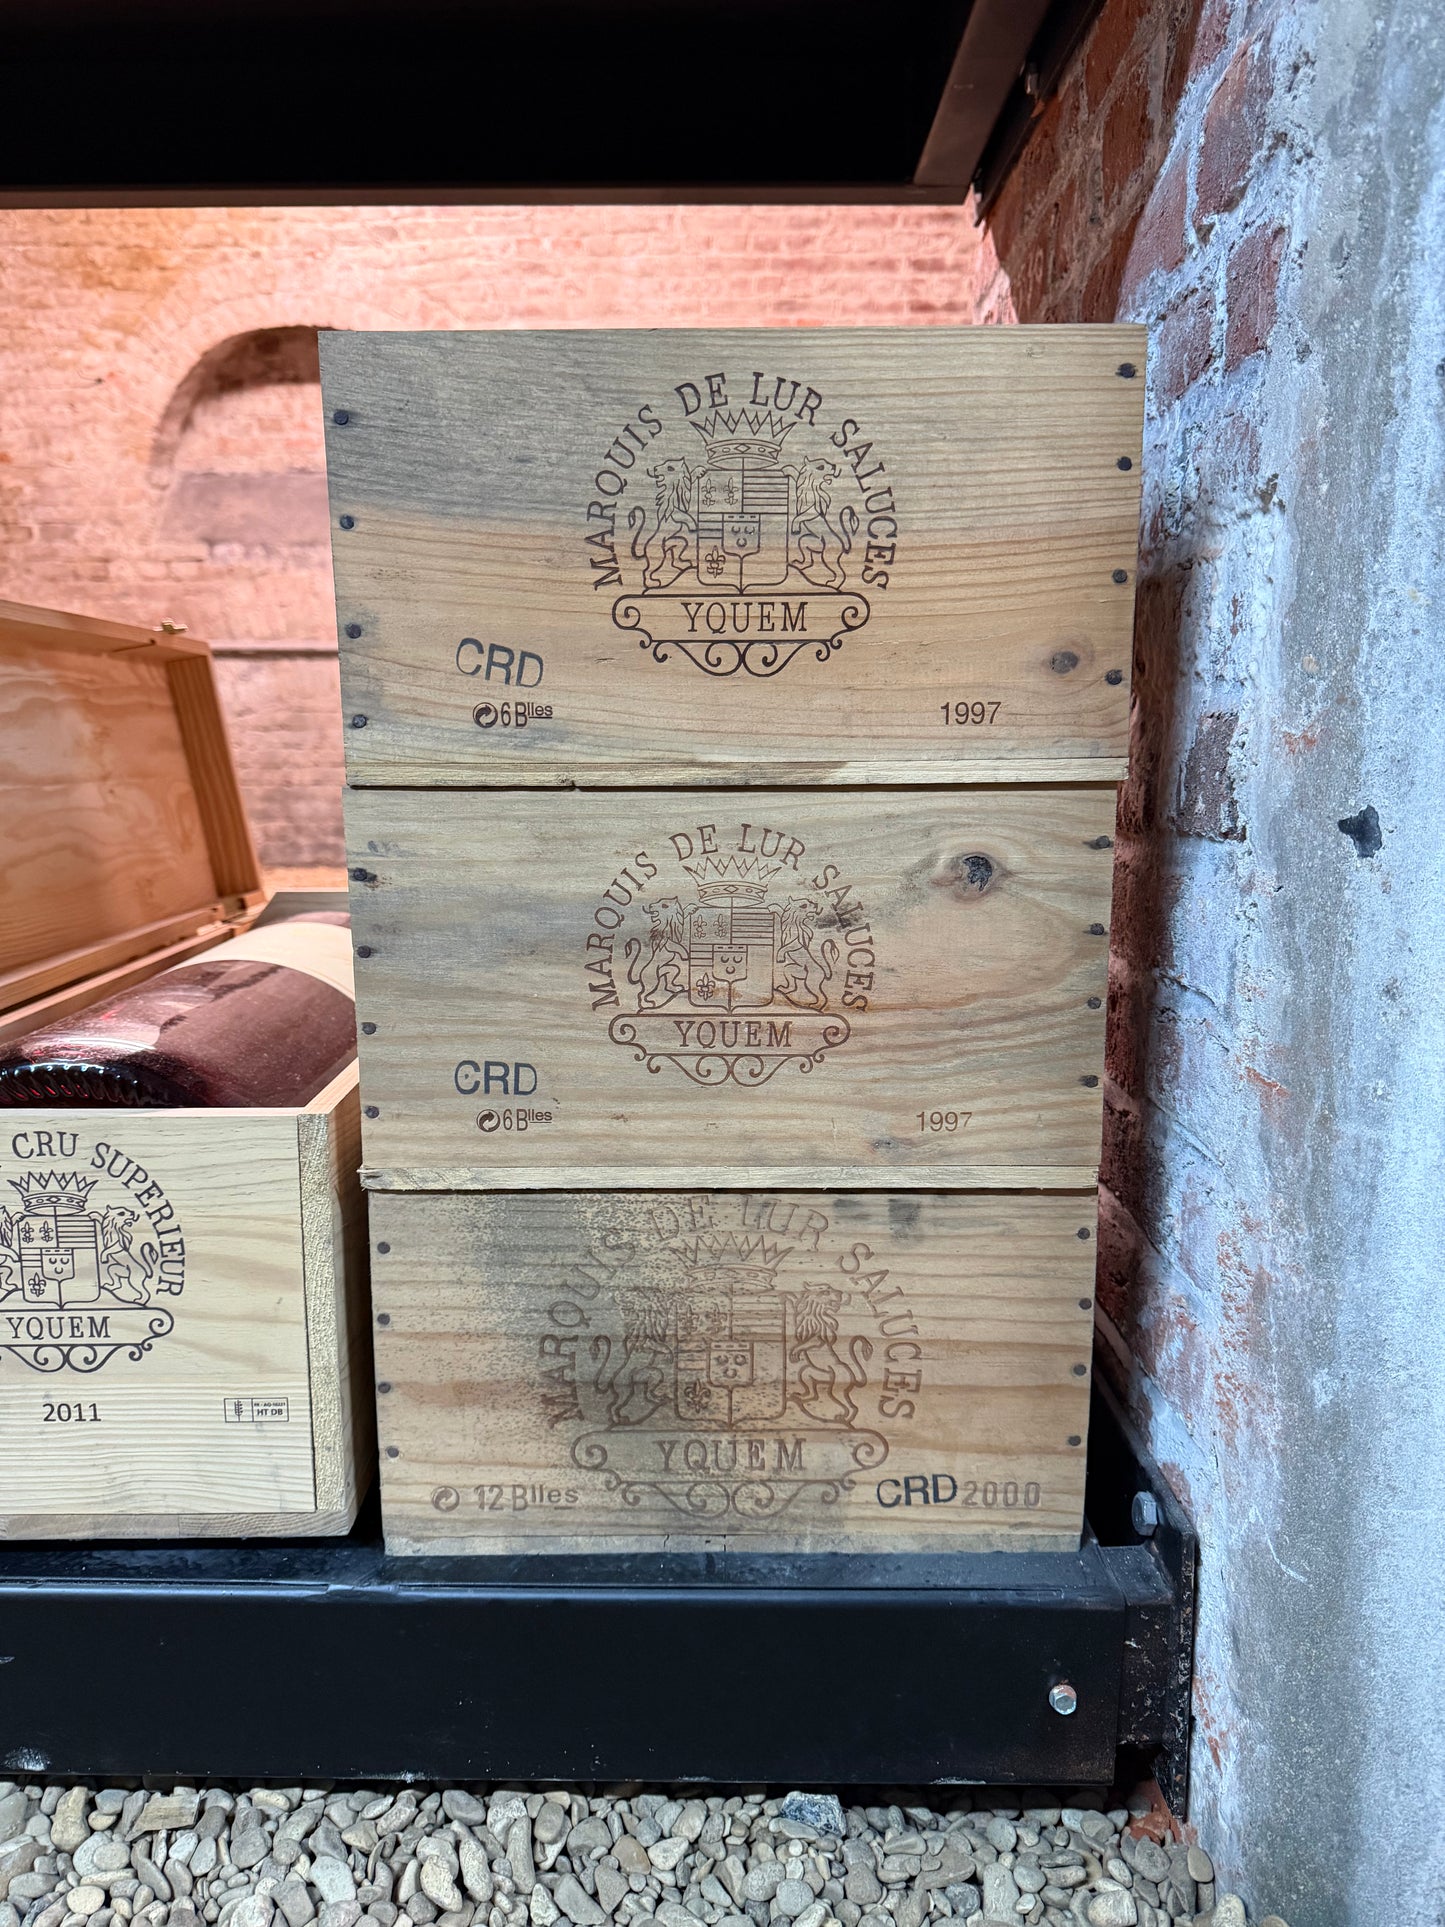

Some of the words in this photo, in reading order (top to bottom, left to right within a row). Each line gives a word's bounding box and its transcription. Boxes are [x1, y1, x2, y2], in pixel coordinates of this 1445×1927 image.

[585, 404, 663, 591] MARQUIS
[675, 372, 728, 416] DE
[750, 371, 823, 426] LUR
[829, 418, 898, 590] SALUCES
[681, 602, 808, 634] YQUEM
[456, 637, 544, 688] CRD
[940, 701, 1002, 725] 1997
[584, 851, 658, 1011] MARQUIS
[669, 824, 719, 860] DE
[737, 823, 806, 871] LUR
[812, 864, 876, 1012] SALUCES
[673, 1020, 792, 1048] YQUEM
[455, 1060, 537, 1096] CRD
[916, 1111, 973, 1132] 1997
[12, 1131, 79, 1159] CRU
[90, 1142, 185, 1297] SUPERIEUR
[539, 1227, 635, 1429] MARQUIS
[649, 1194, 714, 1241] DE
[742, 1194, 829, 1252] LUR
[836, 1242, 923, 1419] SALUCES
[6, 1316, 111, 1340] YQUEM
[42, 1403, 102, 1422] 2011
[257, 1408, 269, 1416] HT
[271, 1408, 283, 1416] DB
[653, 1437, 807, 1474] YQUEM
[474, 1484, 504, 1510] 12
[876, 1474, 958, 1508] CRD
[961, 1480, 1041, 1508] 2000
